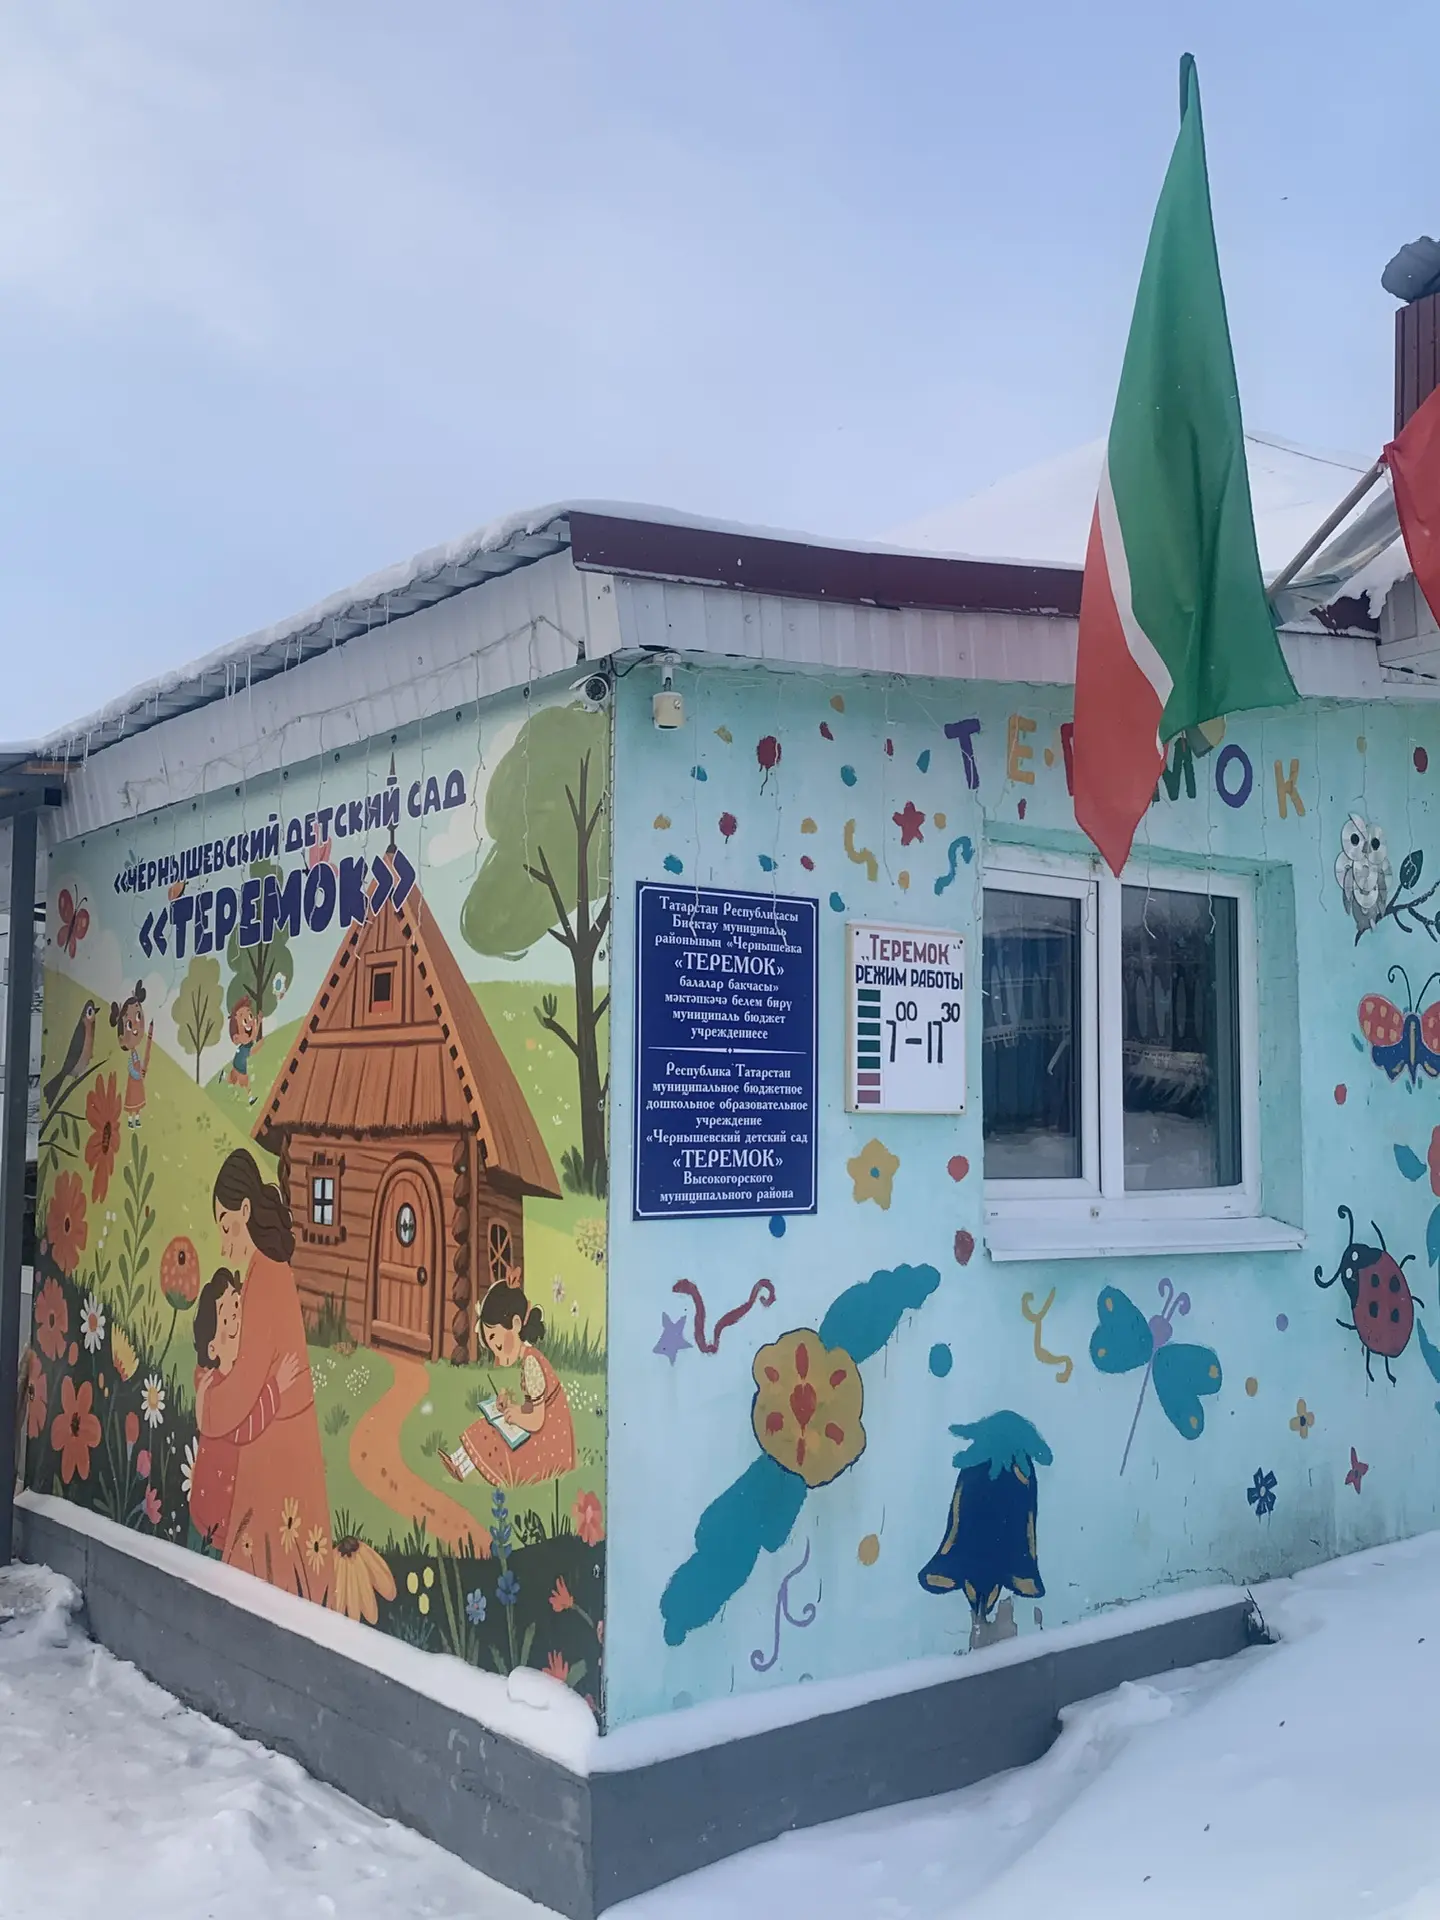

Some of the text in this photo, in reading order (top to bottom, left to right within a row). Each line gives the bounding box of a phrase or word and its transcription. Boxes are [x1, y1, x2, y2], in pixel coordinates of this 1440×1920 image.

[944, 713, 1306, 819] ТЕМОК
[285, 775, 400, 853] ДЕТСКИЙ
[407, 768, 467, 819] САД
[138, 849, 416, 959] «ТЕРЕМОК»
[659, 895, 799, 922] Татарстан Республикасы
[672, 914, 787, 937] Биектау муниципаль
[655, 932, 802, 954] районының «Чернышевка
[674, 952, 784, 976] «ТЕРЕМОК»
[679, 975, 779, 992] балалар бакчасы»
[855, 964, 963, 990] РЕЖИМ РАБОТЫ
[664, 993, 793, 1011] мәктәпкәчә белем бирү
[672, 1010, 786, 1024] муниципаль бюджет
[690, 1026, 768, 1040] учреждениесе
[665, 1061, 791, 1080] Республика Татарстан
[652, 1082, 803, 1096] муниципальное бюджетное
[645, 1098, 808, 1113] дошкольное образовательное
[695, 1116, 763, 1129] учреждение
[646, 1128, 808, 1146] «Чернышевский детский сад
[672, 1148, 783, 1168] «ТЕРЕМОК»
[683, 1170, 773, 1187] Высокогорского
[659, 1186, 794, 1205] муниципального района
